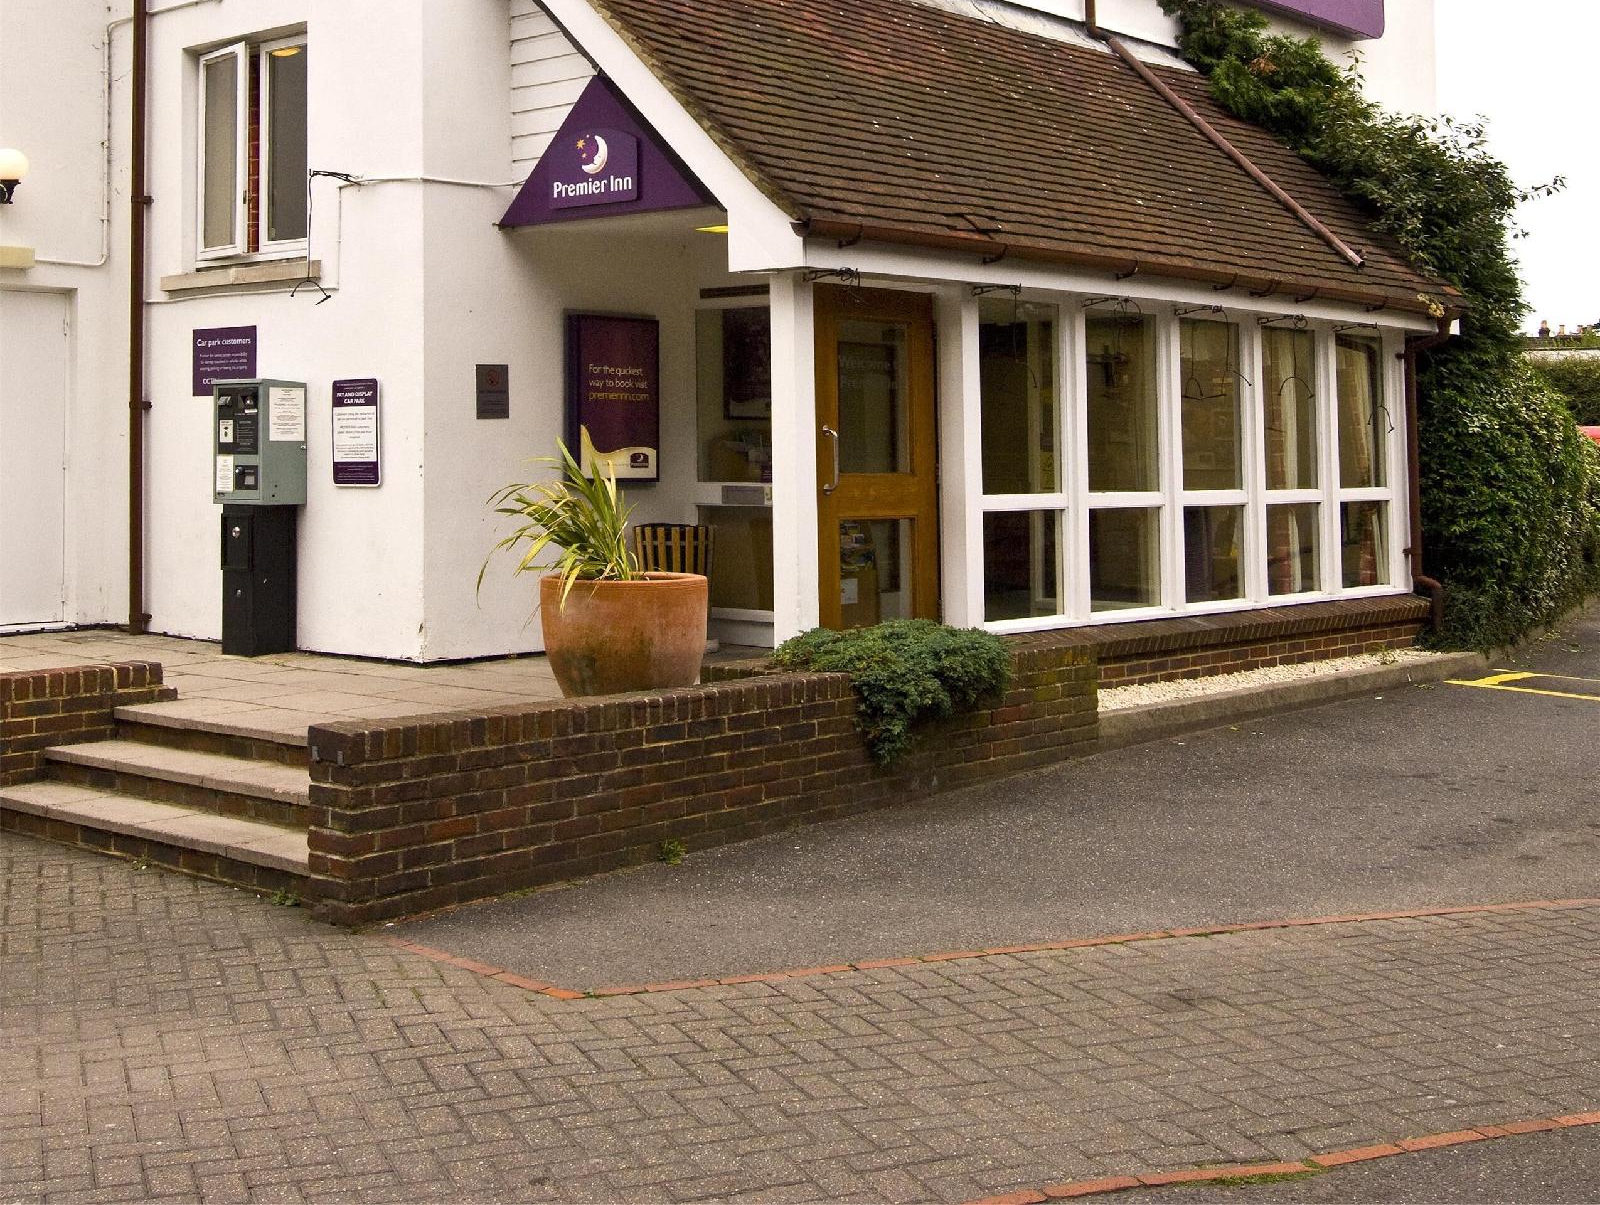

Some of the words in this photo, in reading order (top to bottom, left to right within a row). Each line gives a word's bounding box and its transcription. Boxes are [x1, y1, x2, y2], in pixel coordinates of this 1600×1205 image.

[553, 178, 607, 198] Premier
[610, 175, 632, 192] Inn
[196, 338, 207, 347] Car
[208, 338, 220, 347] park
[589, 363, 601, 374] For
[602, 365, 615, 374] the
[615, 366, 643, 376] quickest
[589, 379, 604, 389] way
[606, 379, 614, 387] to
[615, 378, 633, 388] book
